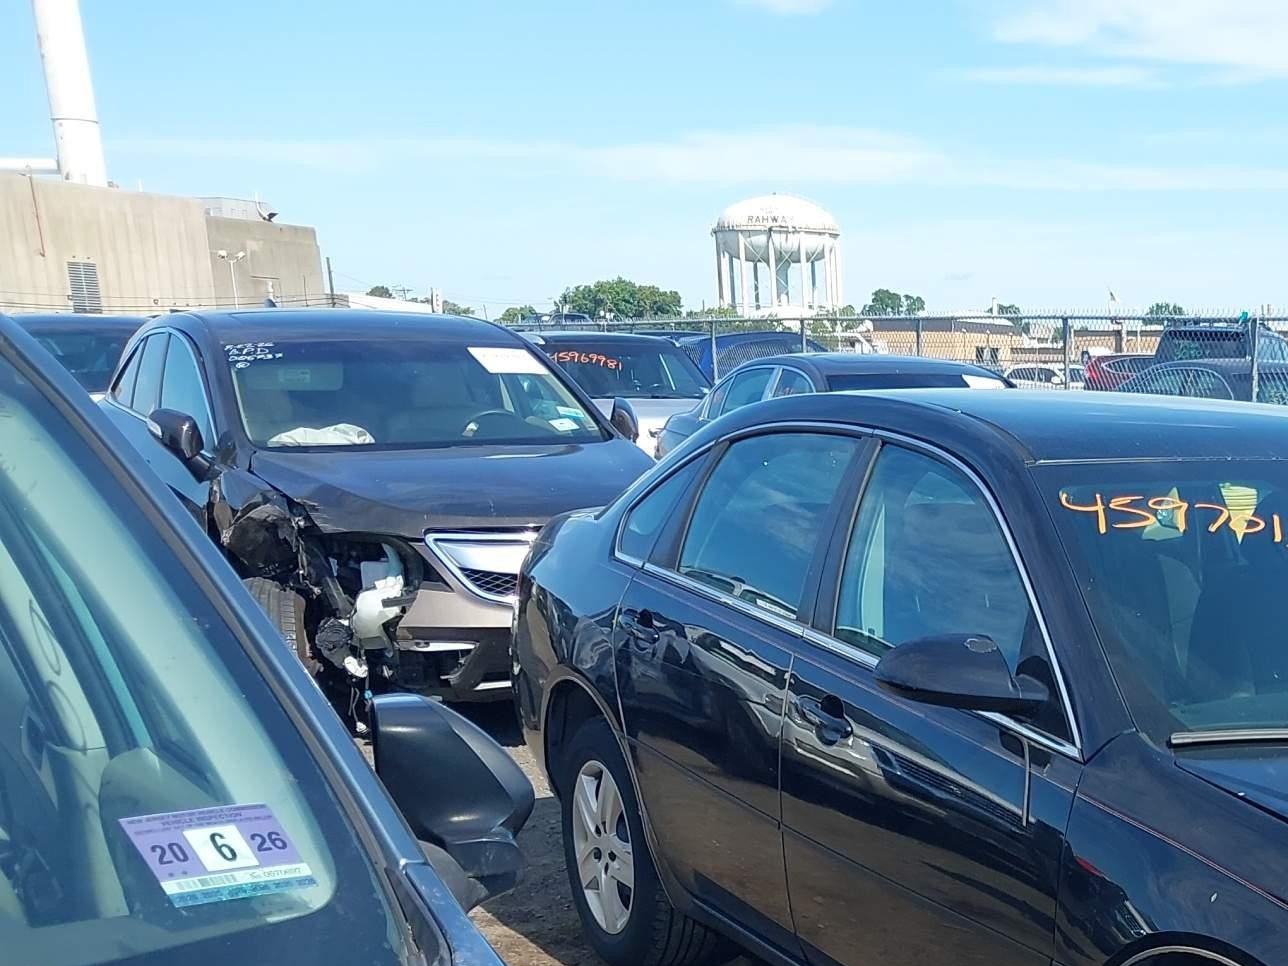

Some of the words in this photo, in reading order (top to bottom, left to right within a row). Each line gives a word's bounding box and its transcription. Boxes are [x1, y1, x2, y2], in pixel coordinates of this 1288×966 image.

[150, 841, 189, 866] 20
[208, 832, 238, 862] 6
[250, 831, 288, 853] 26
